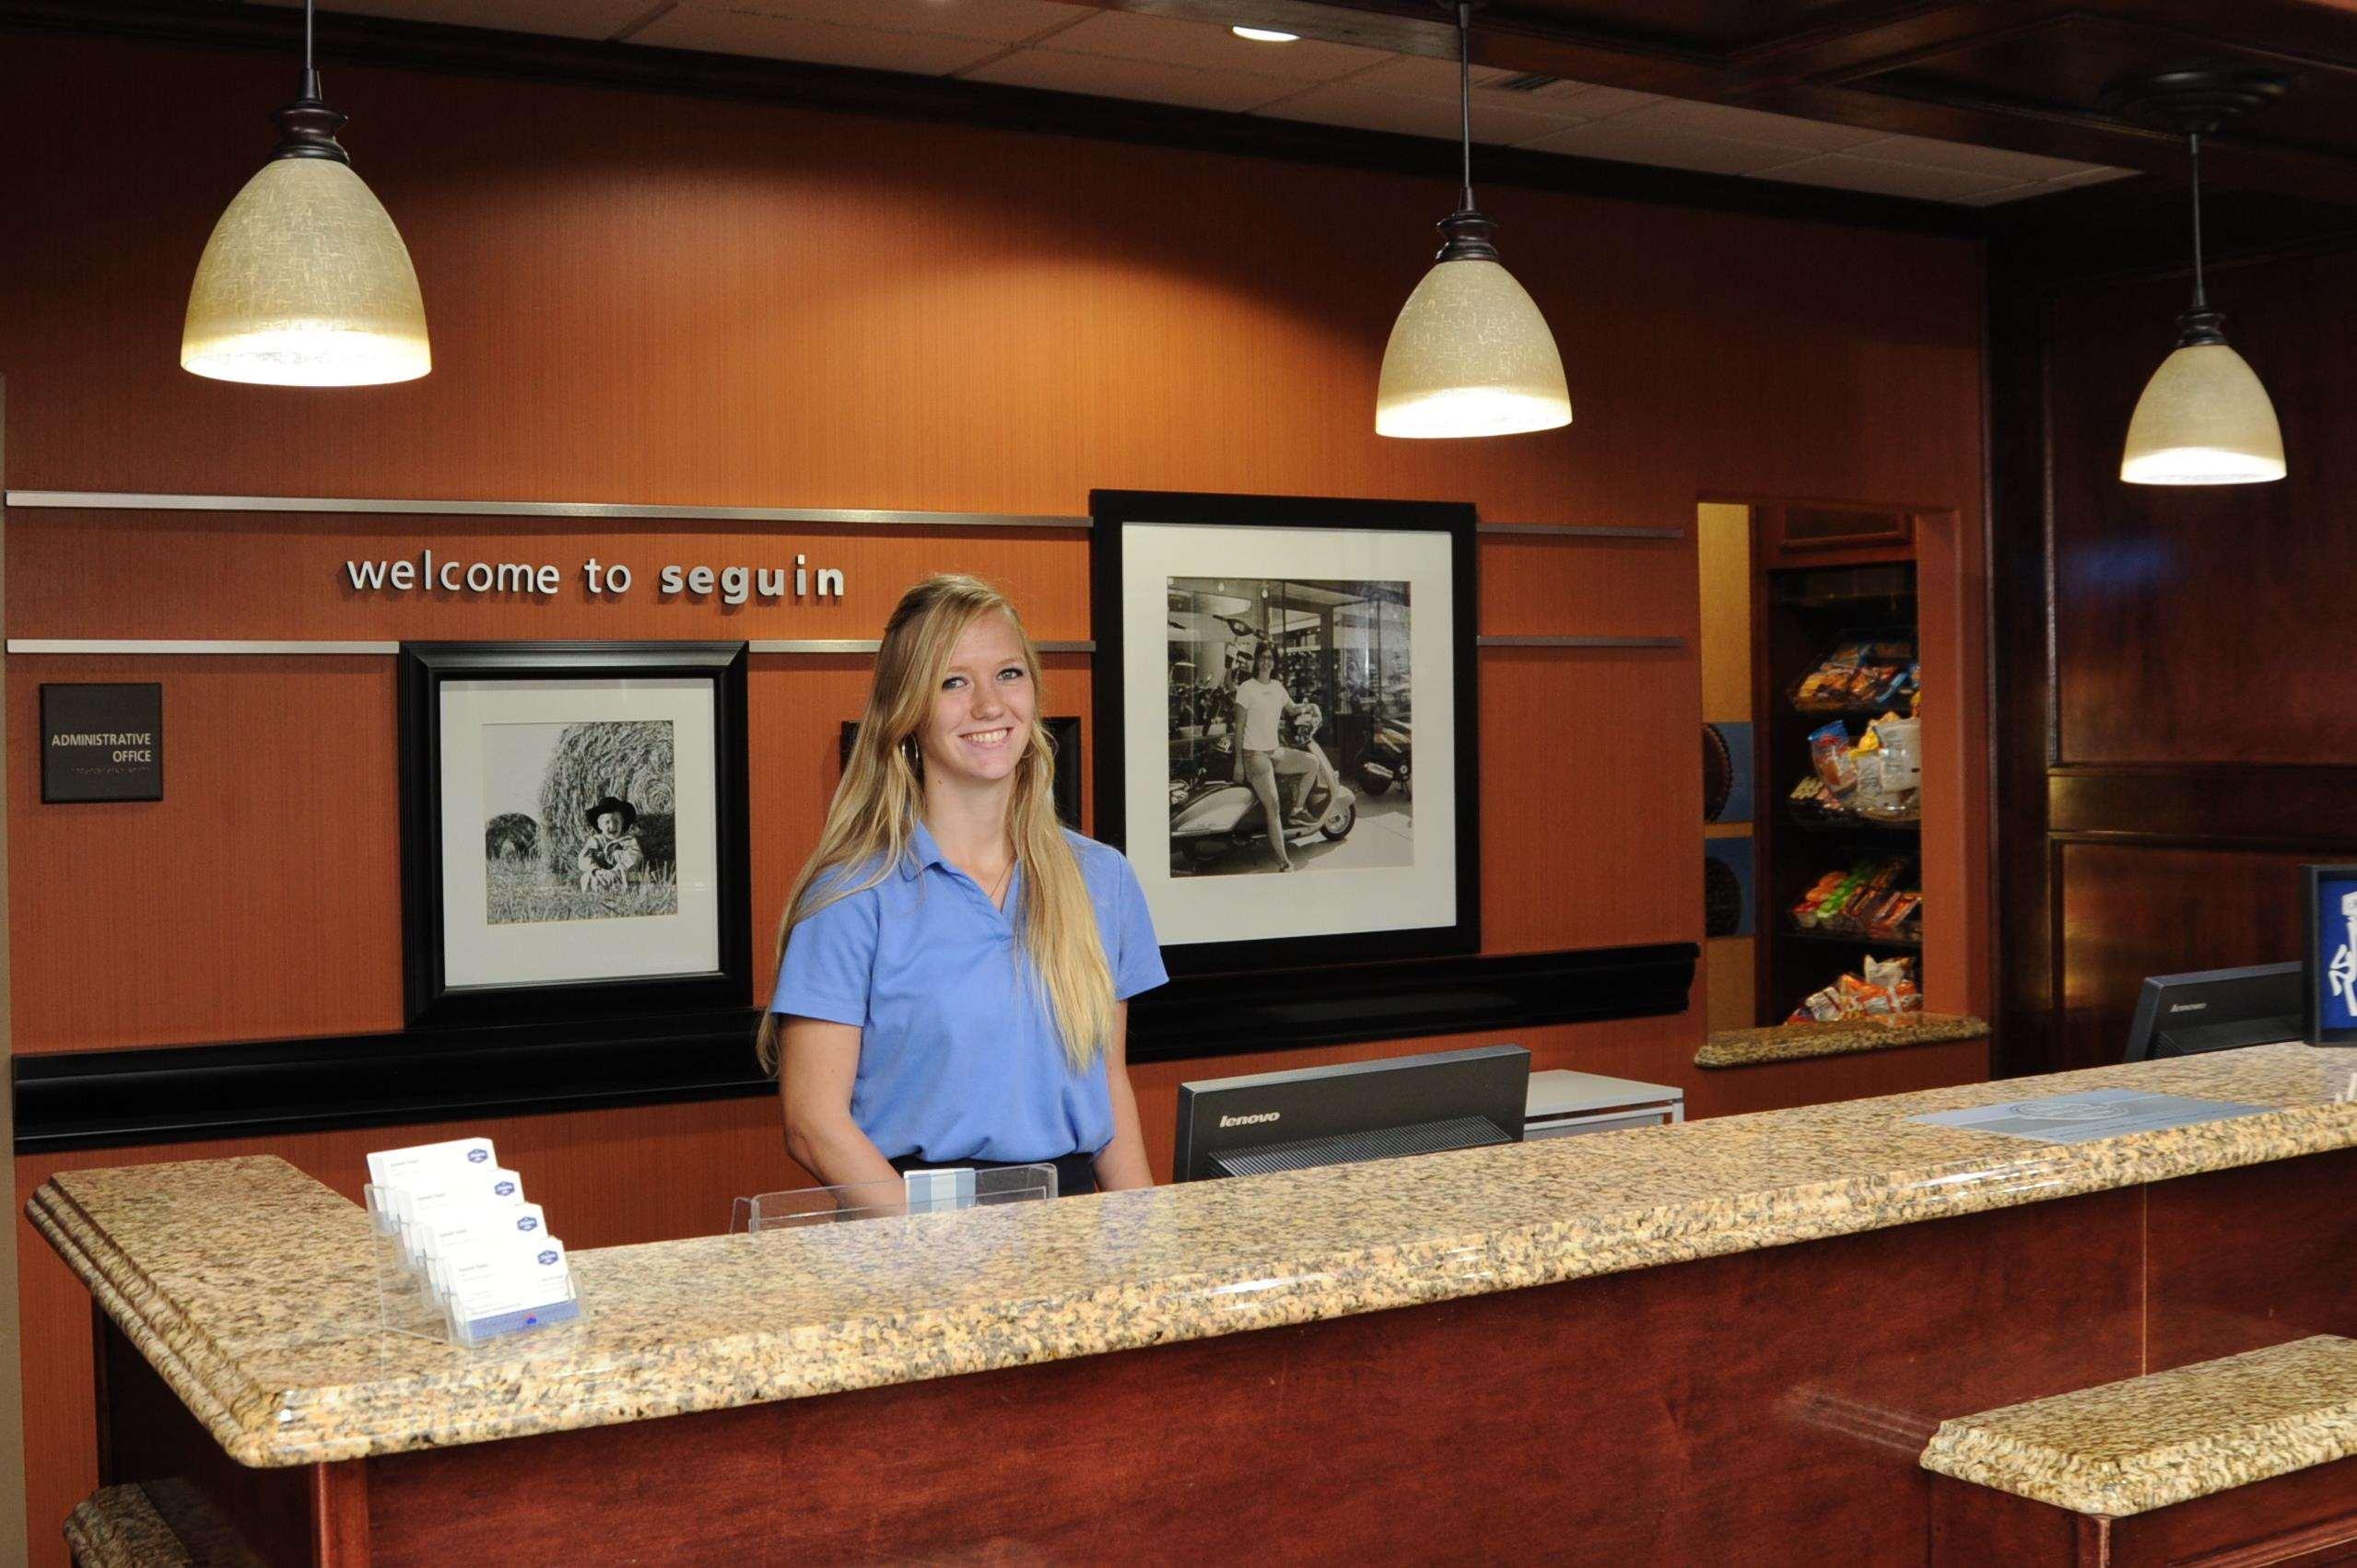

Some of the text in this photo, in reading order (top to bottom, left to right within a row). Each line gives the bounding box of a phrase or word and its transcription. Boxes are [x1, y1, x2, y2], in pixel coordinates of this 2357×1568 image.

[346, 549, 845, 604] welcome to seguin
[52, 733, 152, 746] ADMINISTRATIVE
[112, 751, 152, 763] OFFICE
[1219, 1112, 1281, 1128] lenovo
